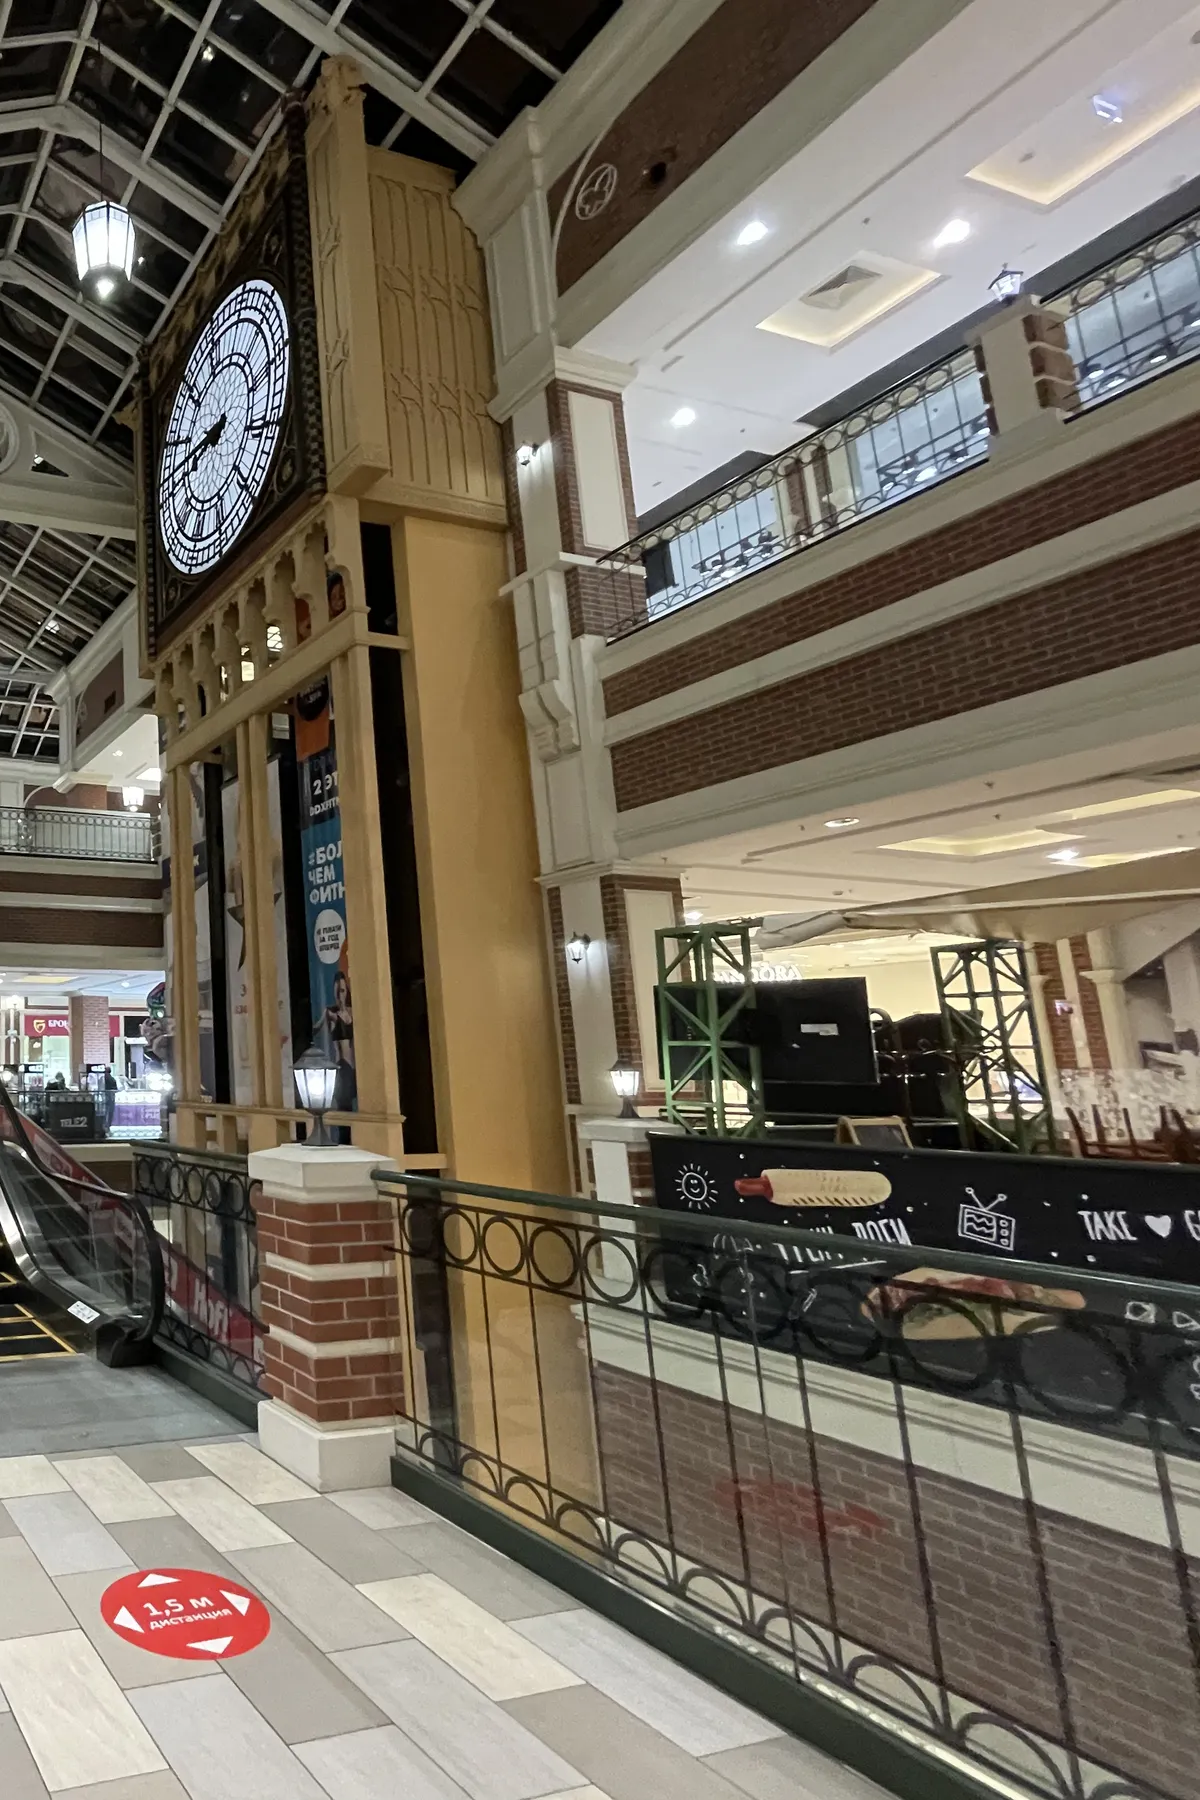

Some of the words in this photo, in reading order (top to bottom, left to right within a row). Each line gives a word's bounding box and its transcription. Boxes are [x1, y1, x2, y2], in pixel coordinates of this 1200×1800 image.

[313, 779, 322, 796] 2
[325, 771, 338, 790] ЭТ
[308, 863, 336, 886] ЧЕМ
[60, 1117, 88, 1128] TELE2
[1078, 1210, 1138, 1240] TAKE
[1184, 1210, 1200, 1241] G
[143, 1598, 184, 1616] 1,5
